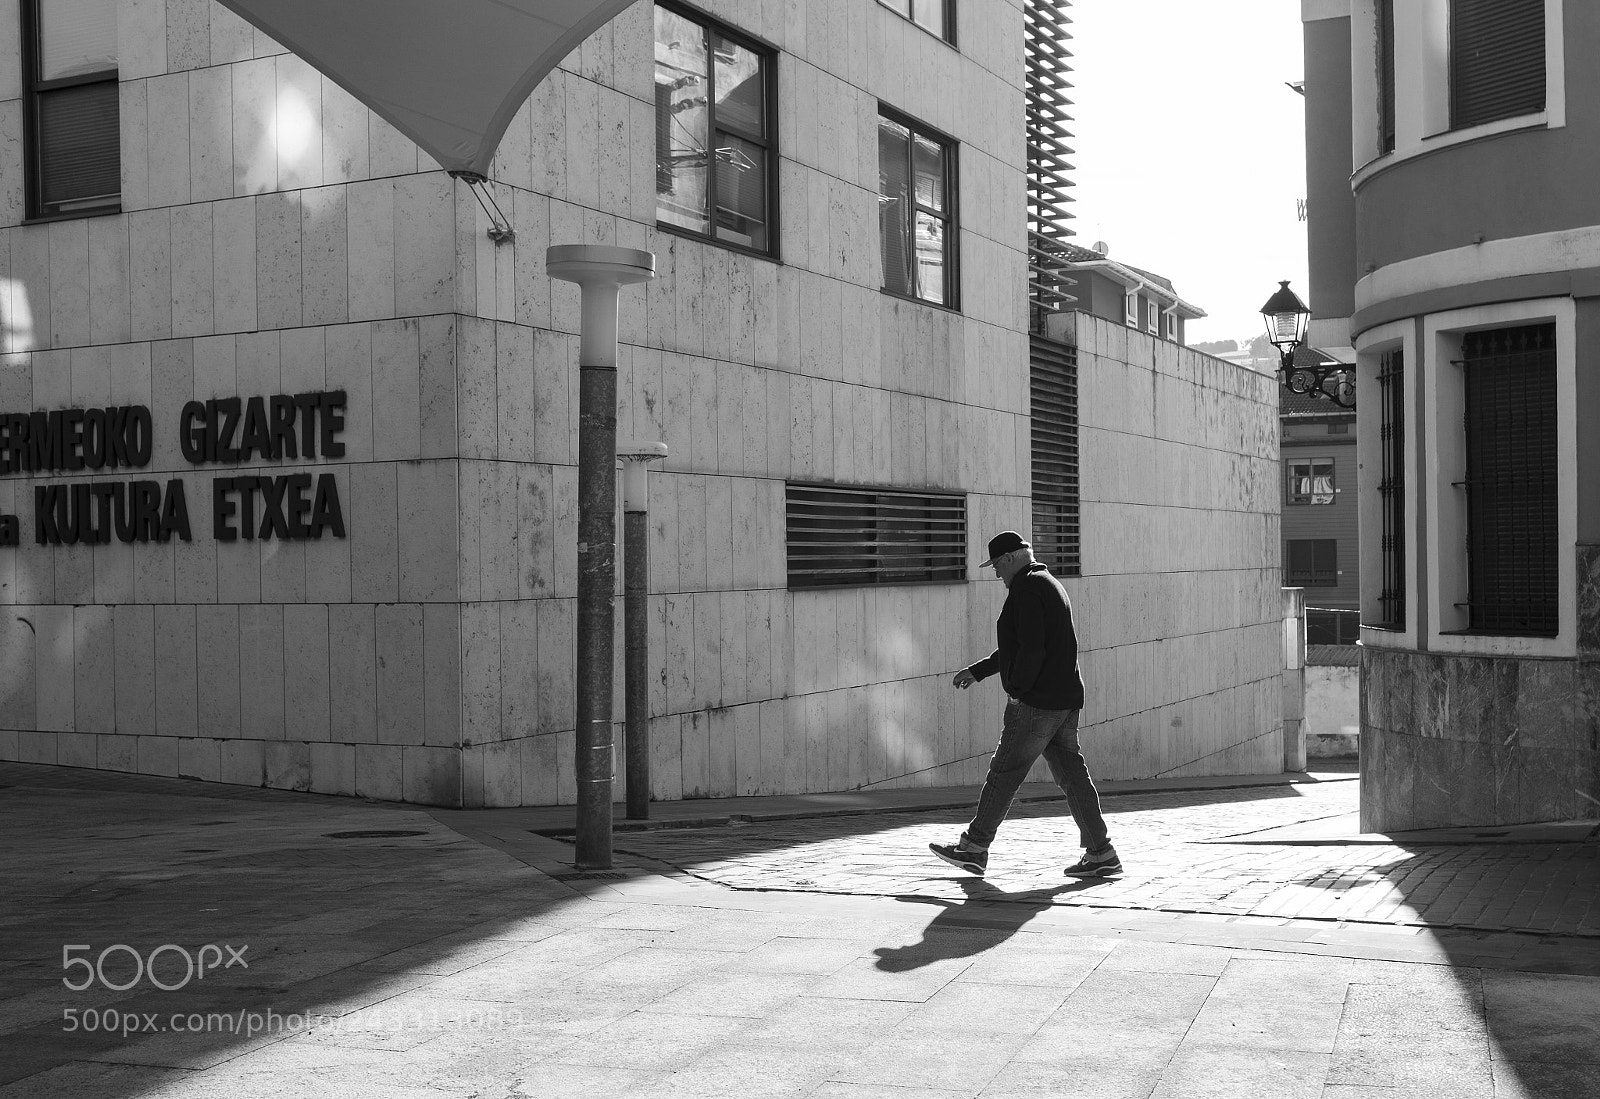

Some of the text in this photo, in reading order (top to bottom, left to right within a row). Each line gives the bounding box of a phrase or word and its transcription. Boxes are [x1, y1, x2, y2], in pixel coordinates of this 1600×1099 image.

[180, 391, 346, 463] GIZARTE
[35, 479, 192, 544] KULTURA
[213, 473, 346, 540] ETXEA
